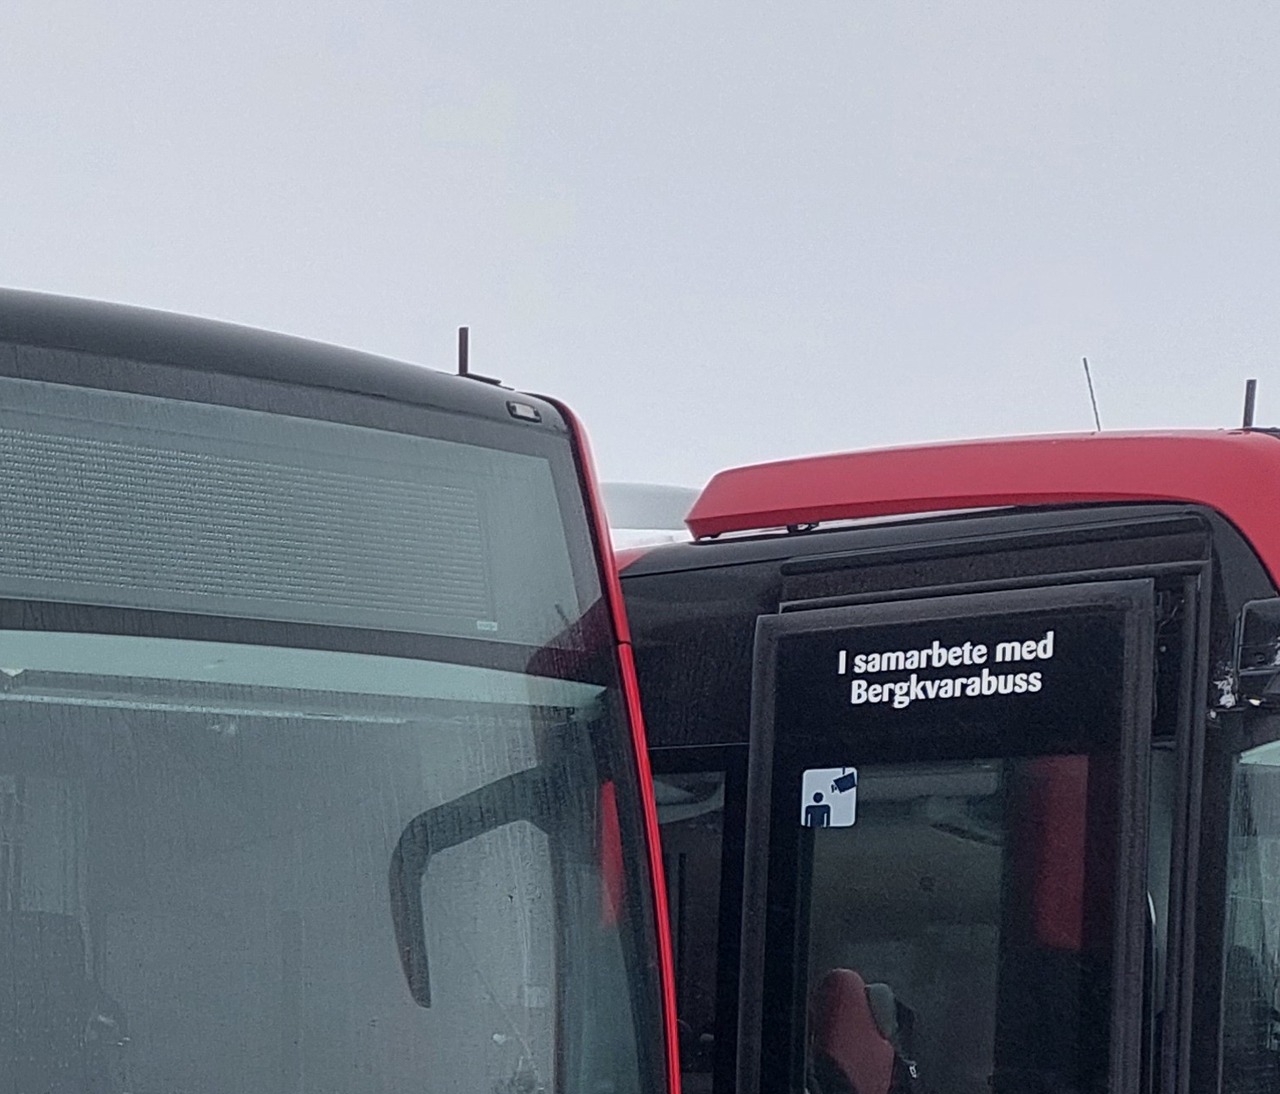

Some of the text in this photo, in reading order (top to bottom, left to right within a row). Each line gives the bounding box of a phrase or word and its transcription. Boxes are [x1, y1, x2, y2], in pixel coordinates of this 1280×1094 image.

[837, 630, 1055, 675] I samarbete med
[850, 667, 1043, 709] Bergkvarabuss
